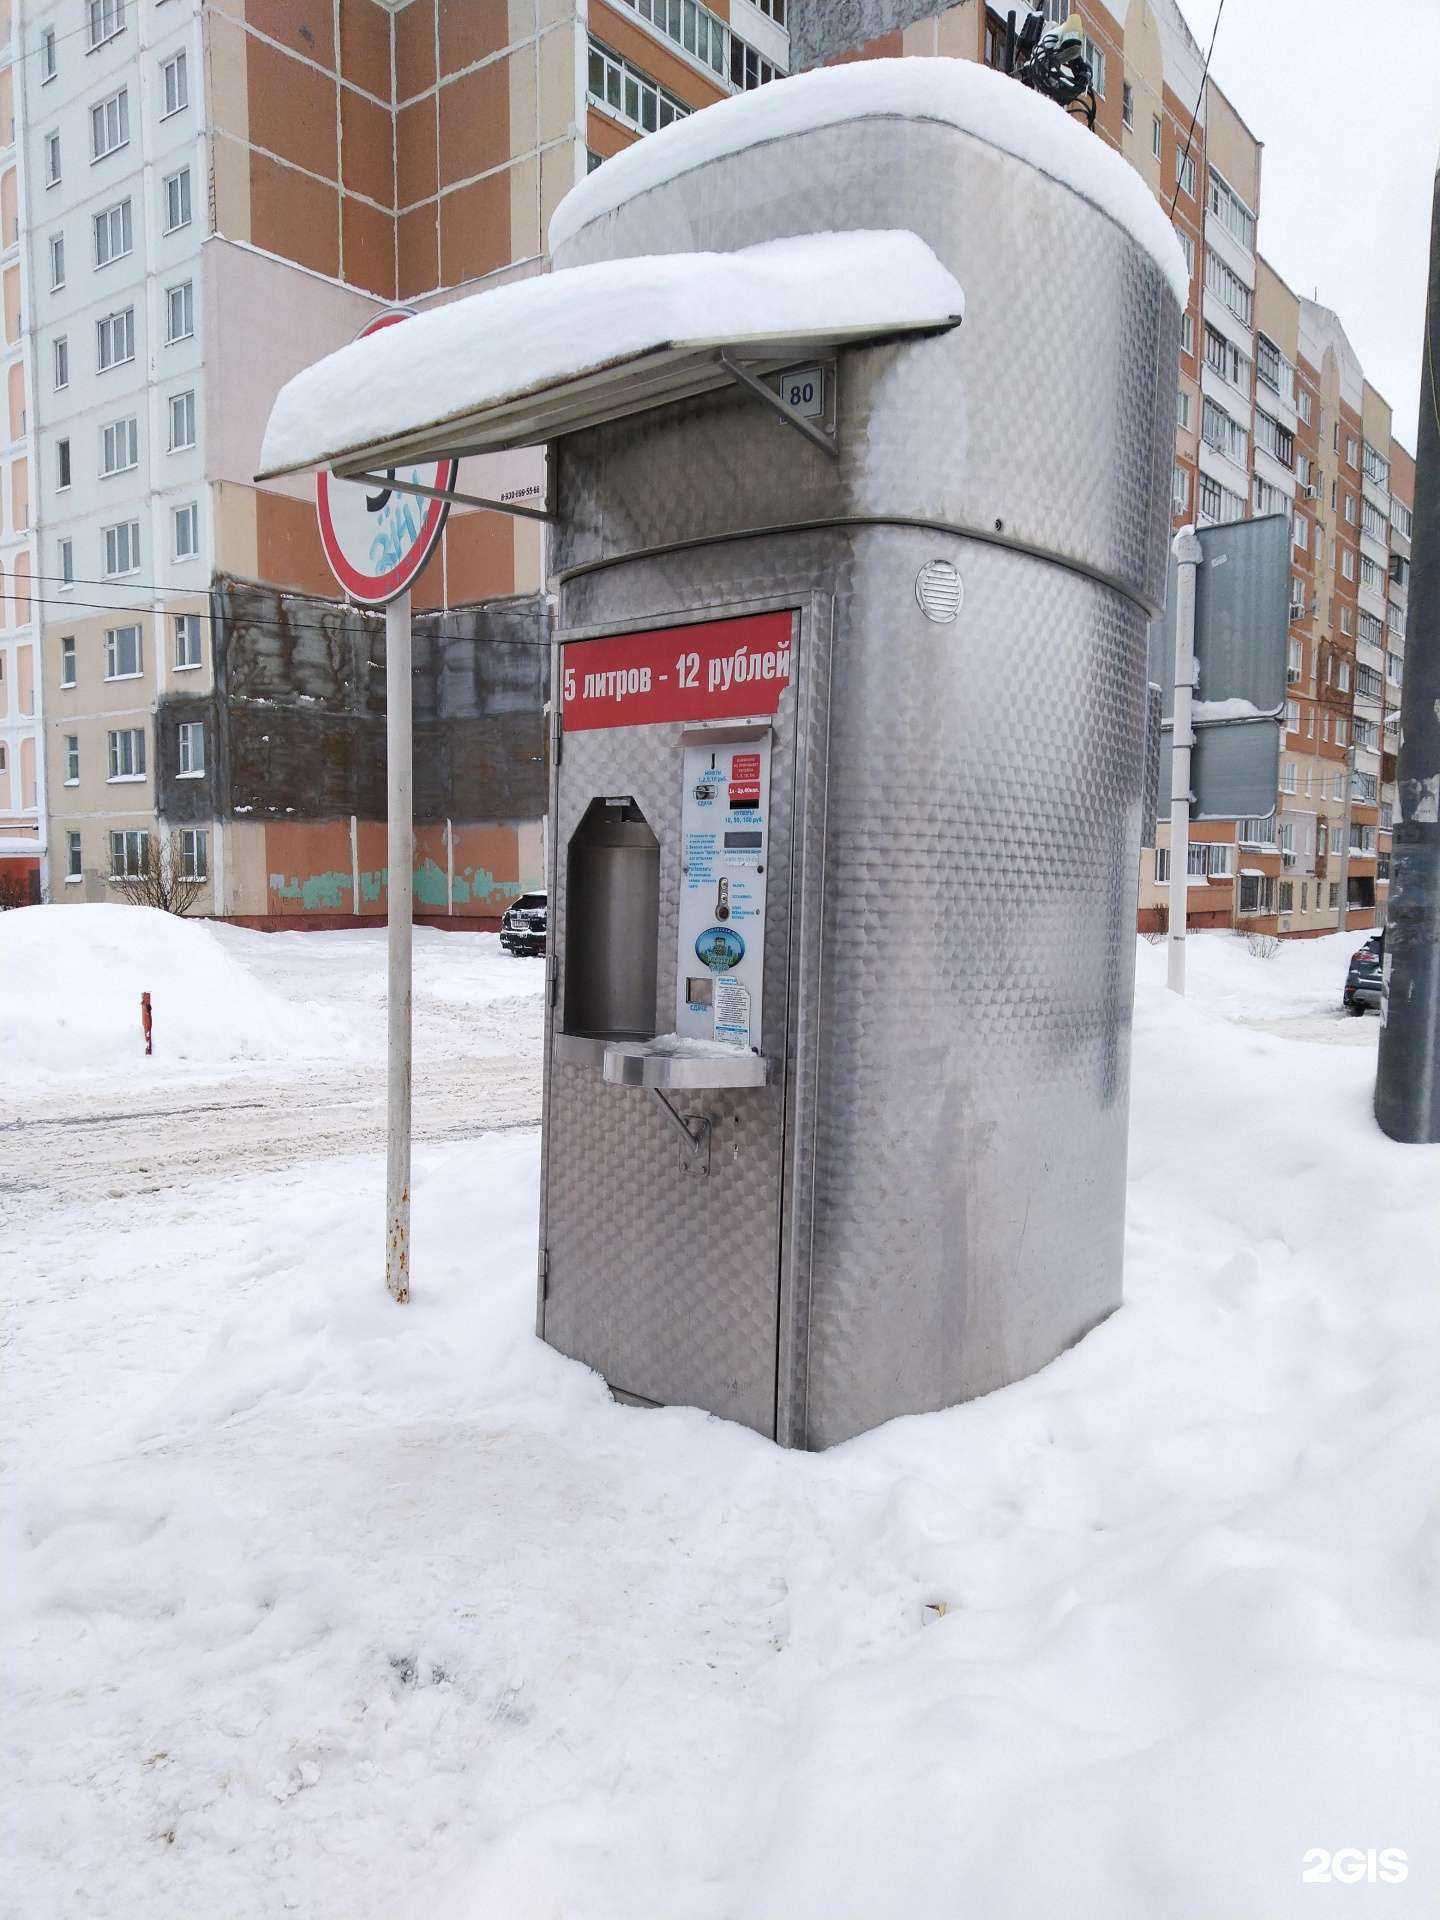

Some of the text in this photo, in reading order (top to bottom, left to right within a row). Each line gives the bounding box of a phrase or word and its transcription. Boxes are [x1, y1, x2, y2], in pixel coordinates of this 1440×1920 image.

[790, 383, 814, 406] 80
[564, 668, 576, 701] 5
[582, 667, 652, 702] литров
[675, 652, 700, 689] 12
[708, 640, 790, 693] рублей
